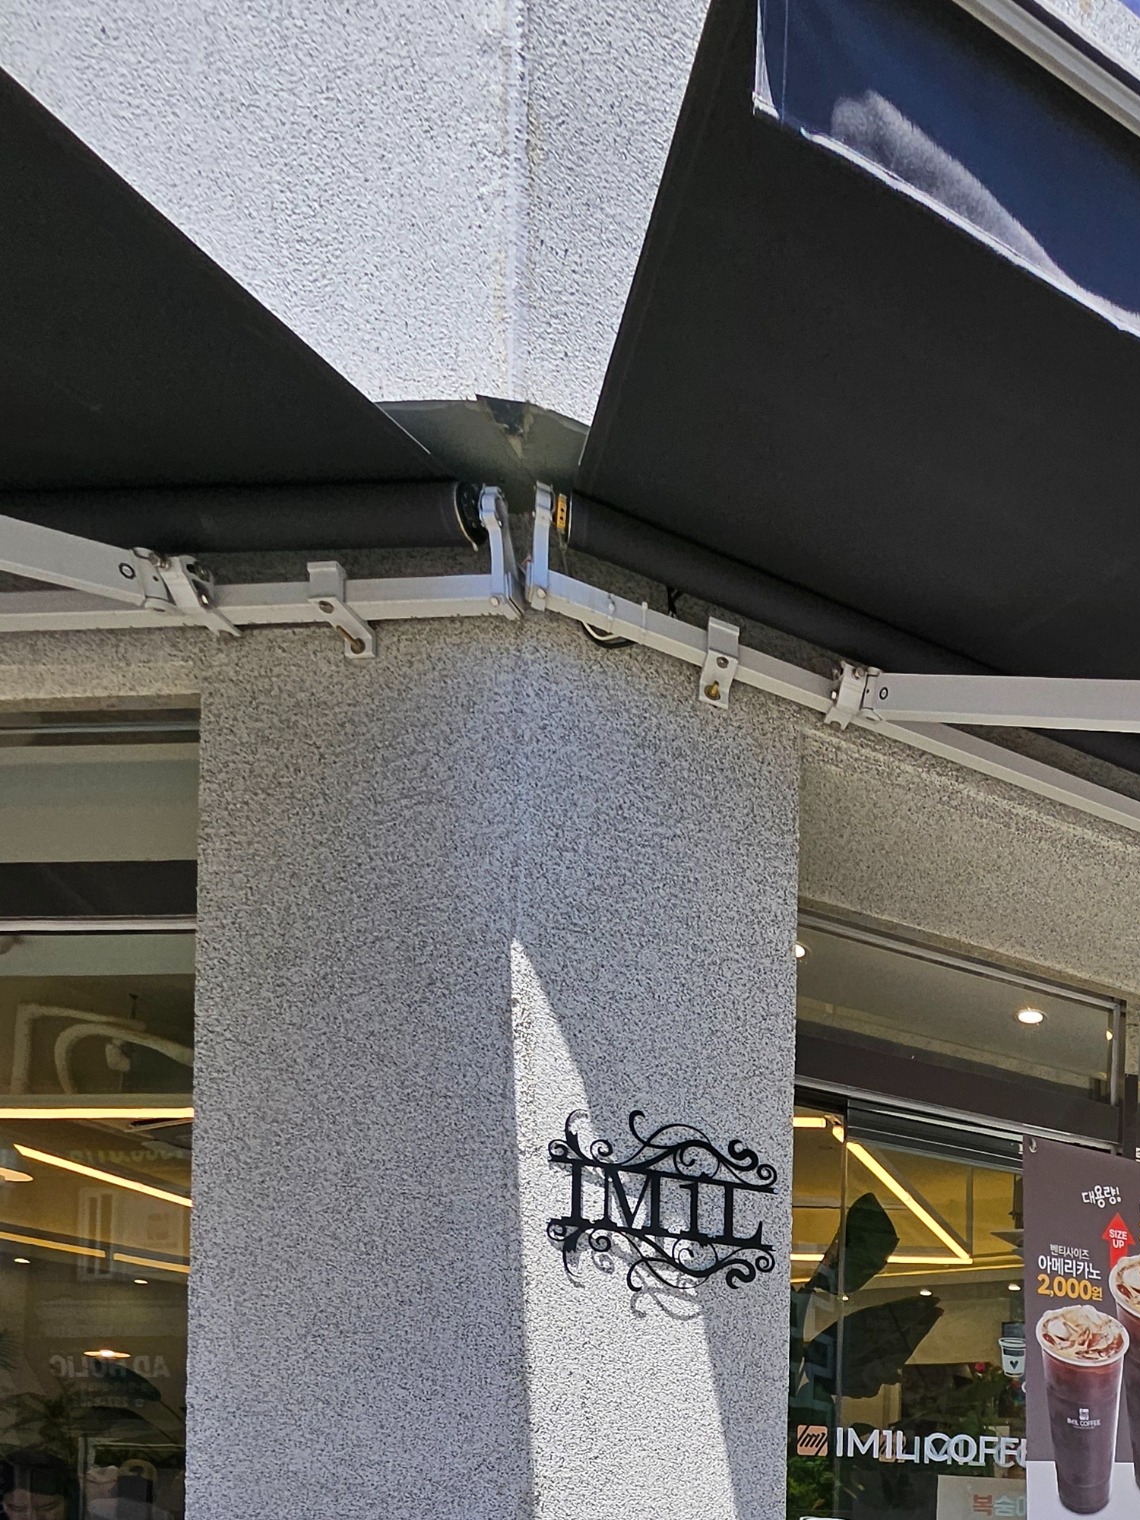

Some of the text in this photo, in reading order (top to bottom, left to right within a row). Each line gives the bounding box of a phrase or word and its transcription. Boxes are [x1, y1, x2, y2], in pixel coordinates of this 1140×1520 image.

[1081, 1185, 1121, 1208] 대용량!
[1109, 1229, 1128, 1240] SIZE
[1113, 1239, 1124, 1249] UP
[1050, 1244, 1090, 1260] 벤티사이즈
[1038, 1255, 1102, 1280] 아메리카노
[1037, 1274, 1103, 1301] 2,000원
[926, 1432, 1027, 1467] COFF
